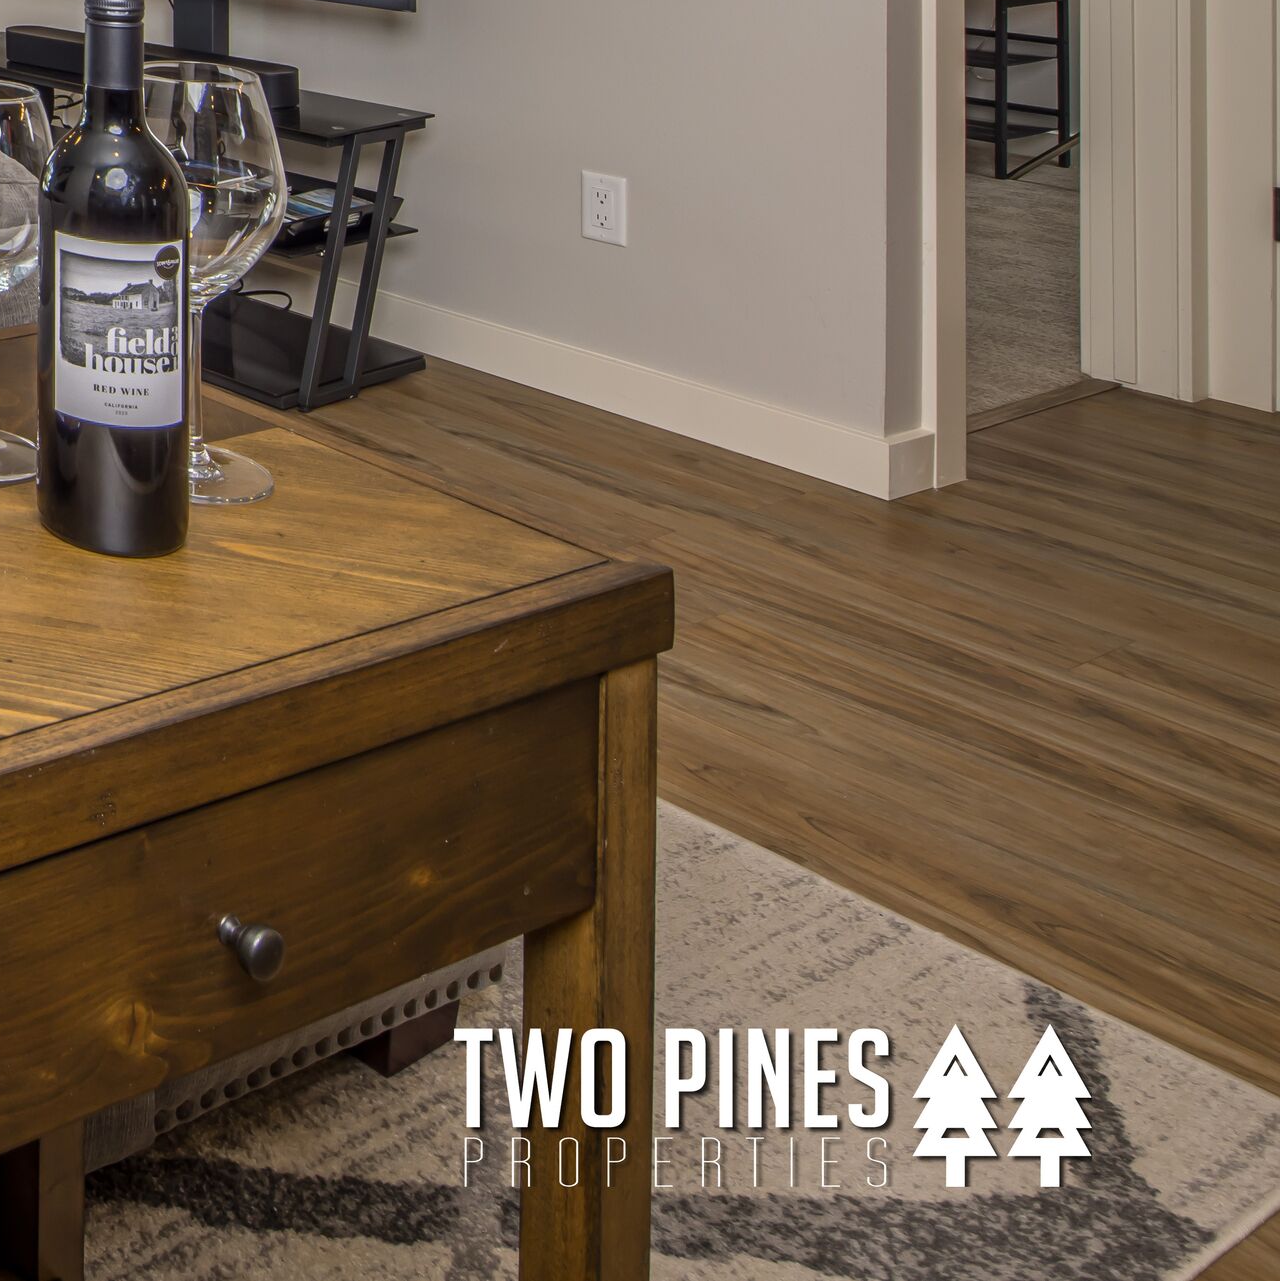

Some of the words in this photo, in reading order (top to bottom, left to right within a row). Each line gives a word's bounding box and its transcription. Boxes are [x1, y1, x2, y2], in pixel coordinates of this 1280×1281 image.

[105, 326, 170, 355] field
[84, 342, 171, 374] house
[93, 383, 117, 394] RED
[120, 387, 150, 396] WINE
